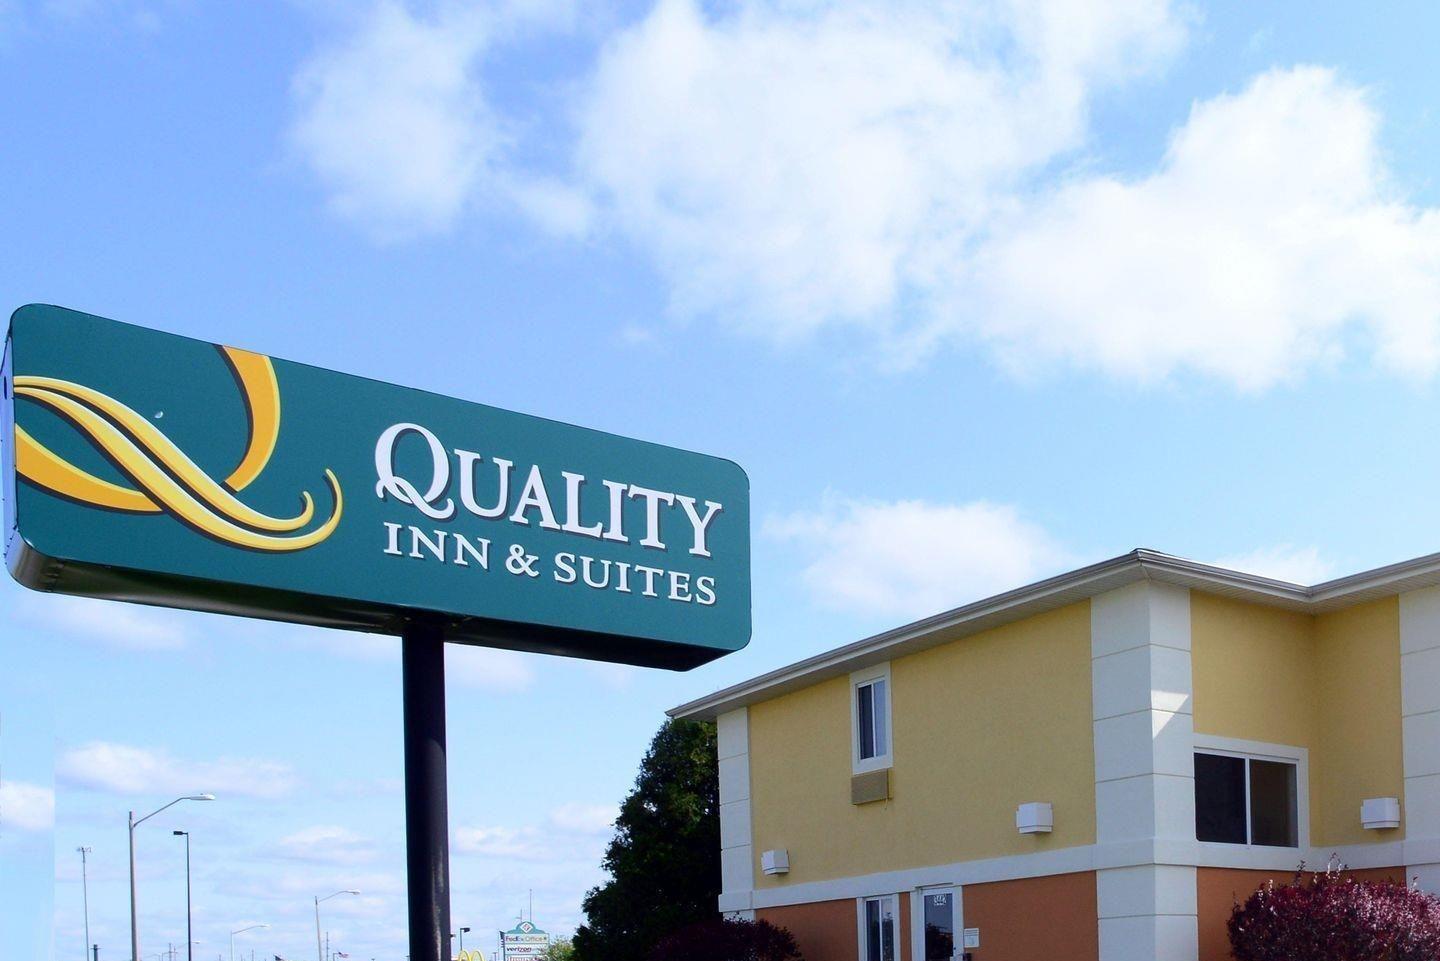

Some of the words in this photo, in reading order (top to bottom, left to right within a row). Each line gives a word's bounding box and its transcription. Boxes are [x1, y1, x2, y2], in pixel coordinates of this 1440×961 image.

[375, 422, 722, 557] QUALITY
[383, 521, 491, 570] INN
[505, 543, 540, 577] &
[553, 552, 717, 606] SUITES
